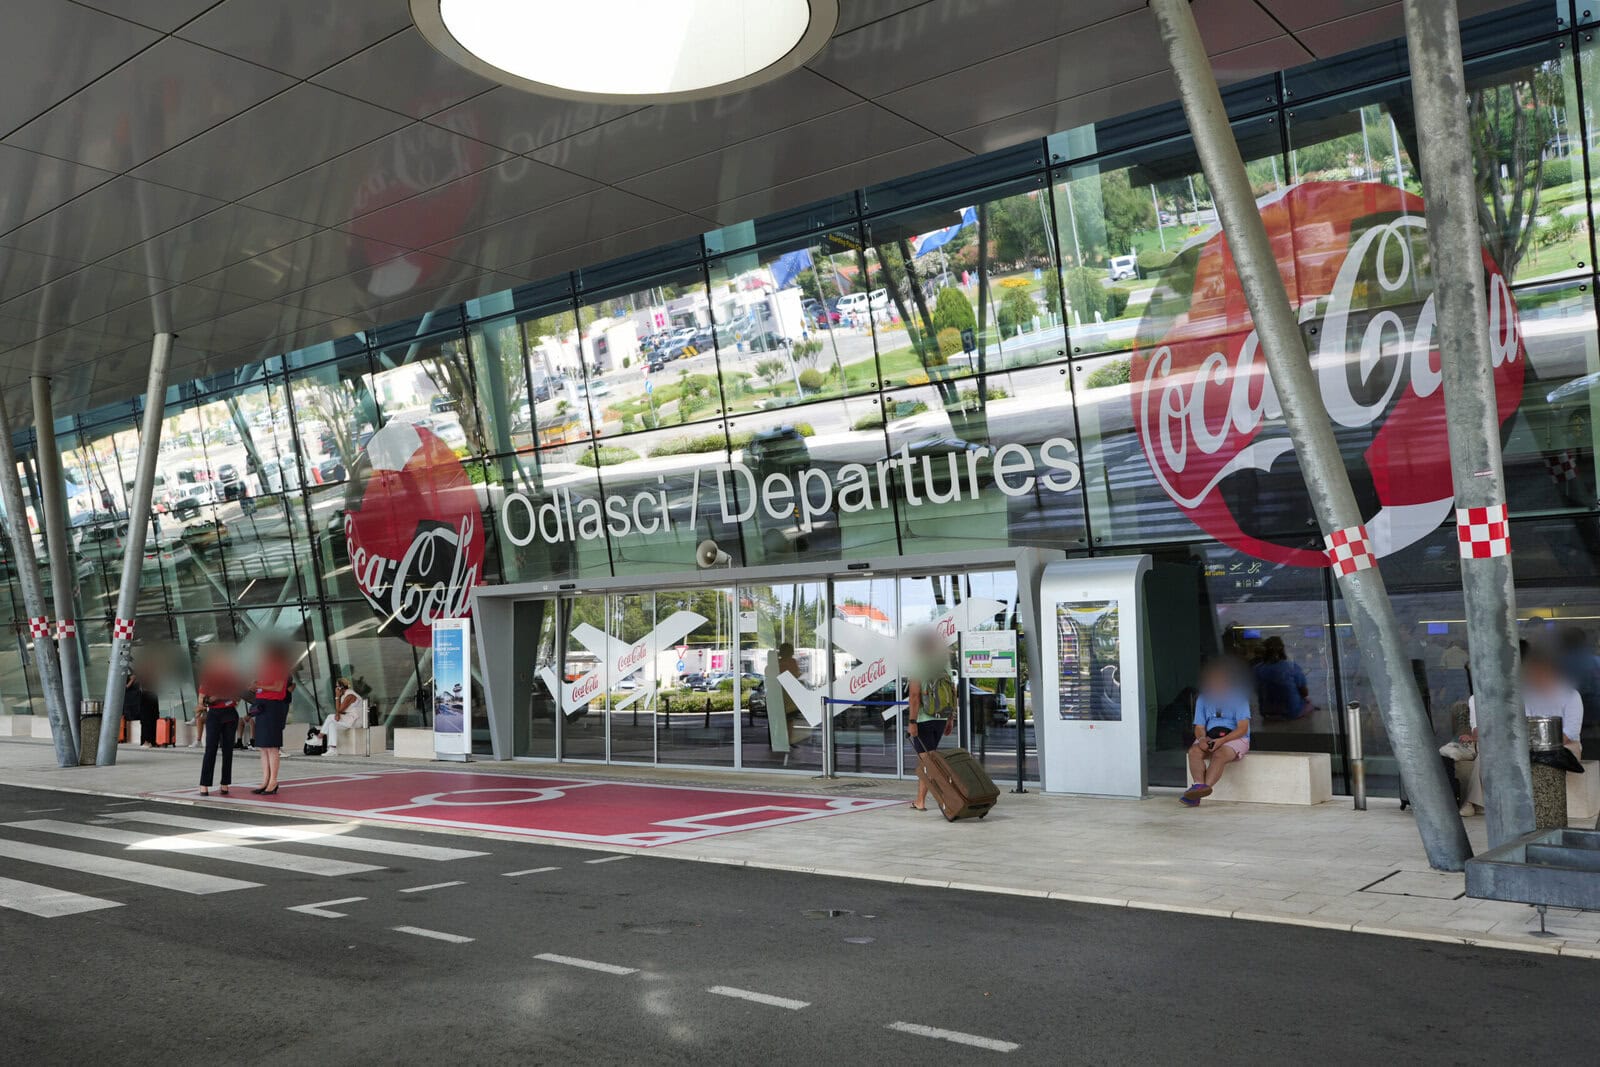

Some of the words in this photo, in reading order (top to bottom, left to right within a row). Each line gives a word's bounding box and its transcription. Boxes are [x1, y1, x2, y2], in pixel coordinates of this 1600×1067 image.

[1141, 215, 1518, 508] CocaCoa
[502, 475, 670, 546] Odlasci
[690, 469, 700, 531] /
[716, 437, 1081, 533] Departures
[618, 643, 646, 671] Coca-Cola
[572, 674, 598, 702] Coca-Cola
[850, 658, 886, 694] Coca-Cola
